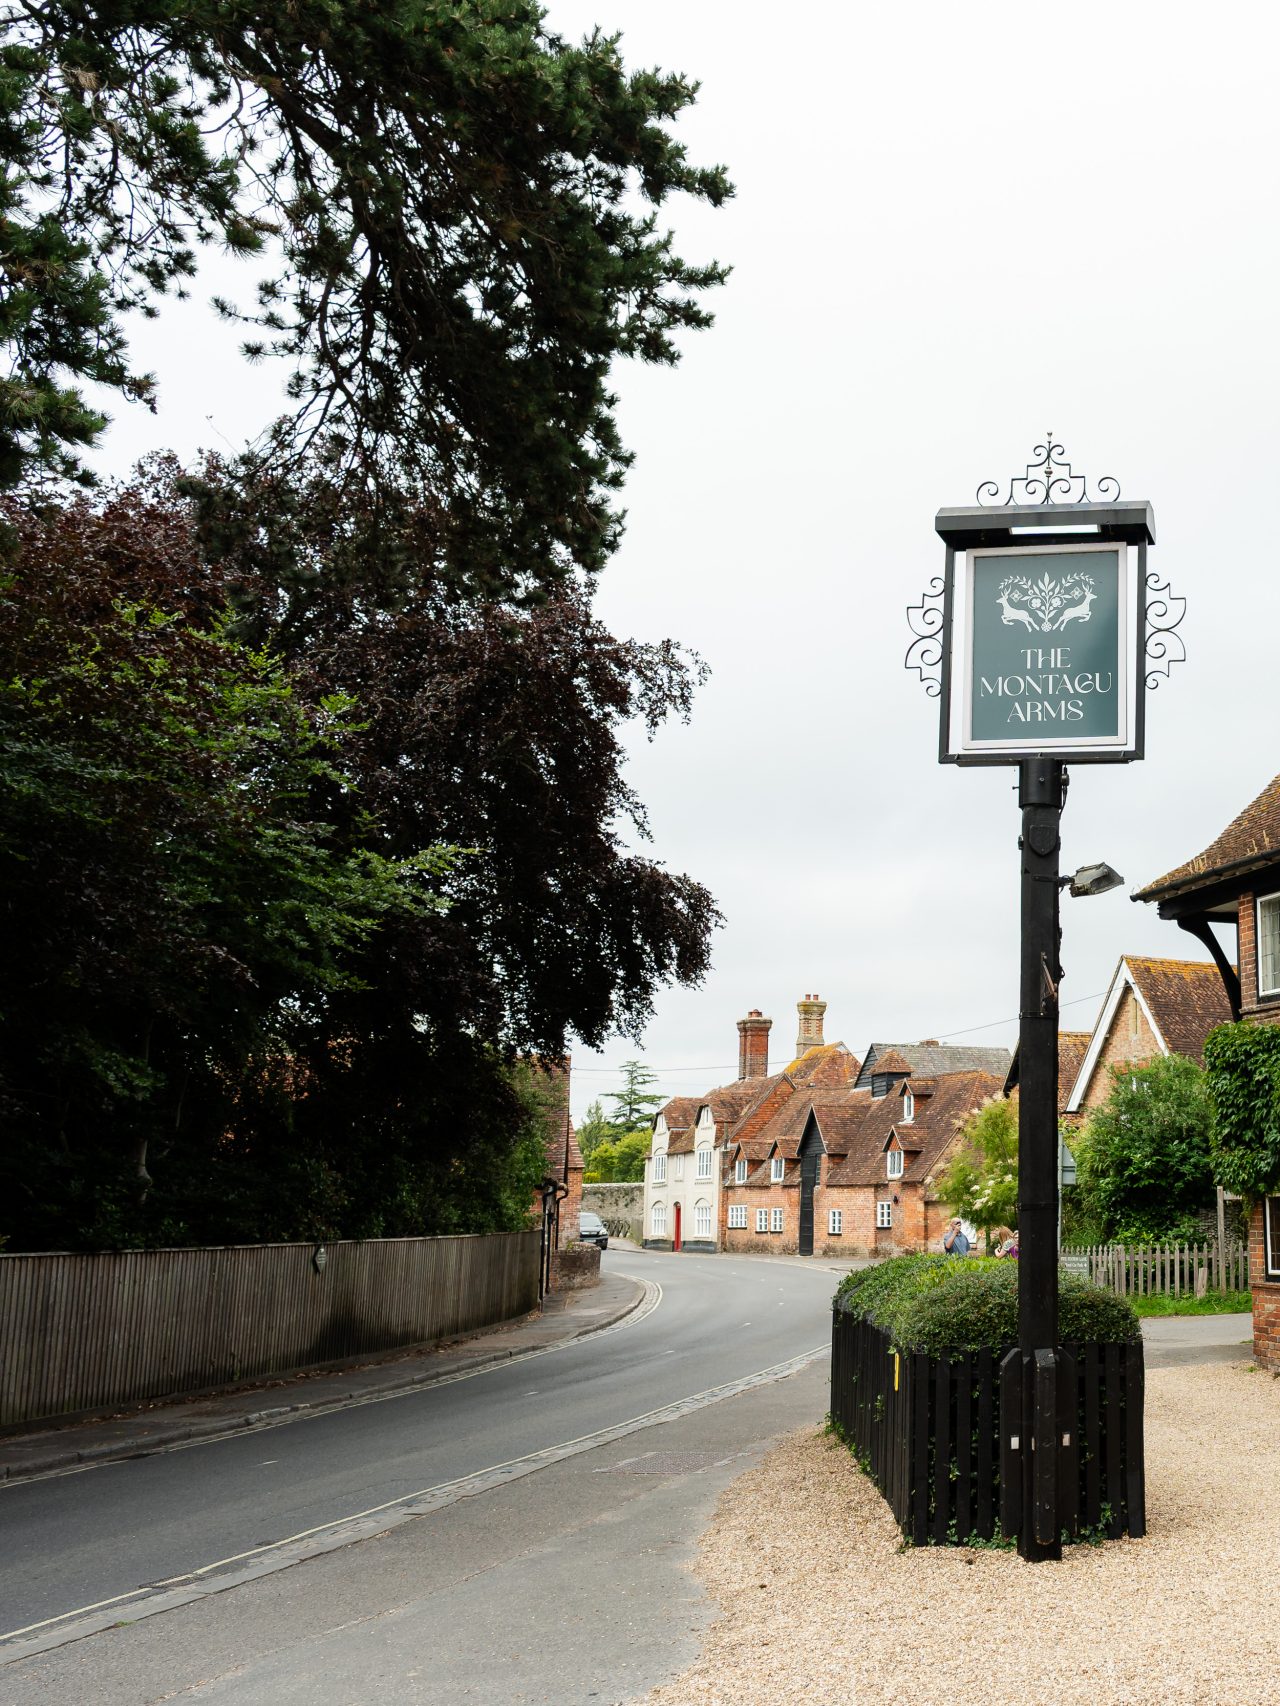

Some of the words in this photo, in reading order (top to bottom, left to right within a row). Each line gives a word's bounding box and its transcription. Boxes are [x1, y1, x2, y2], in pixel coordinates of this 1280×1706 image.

[1020, 647, 1071, 669] THE
[980, 672, 1112, 697] MONTAGU
[1007, 700, 1084, 723] ARMS
